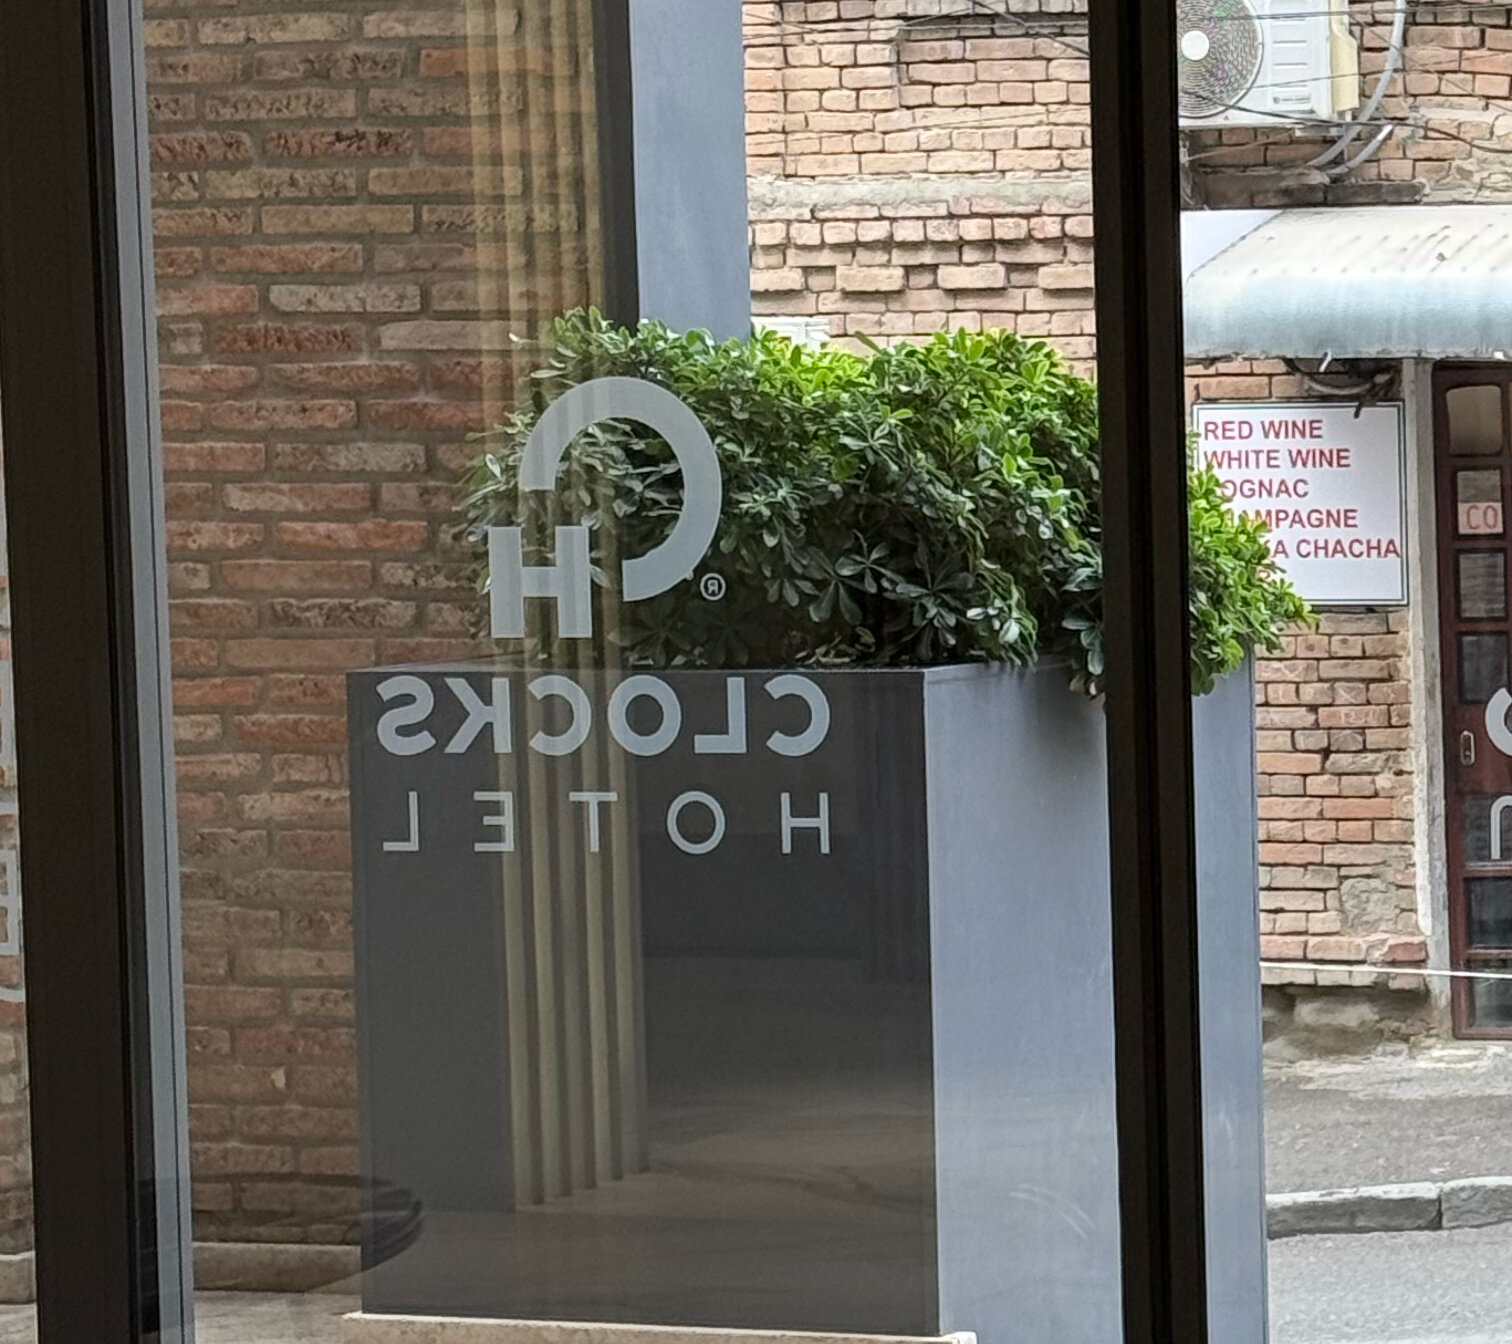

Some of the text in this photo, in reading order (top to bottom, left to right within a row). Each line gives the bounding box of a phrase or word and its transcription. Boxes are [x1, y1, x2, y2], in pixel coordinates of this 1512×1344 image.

[1203, 419, 1323, 441] RED WINE
[1203, 448, 1351, 469] WHITE WINE
[1212, 478, 1309, 499] OGNAC
[1296, 539, 1400, 558] CHACHA
